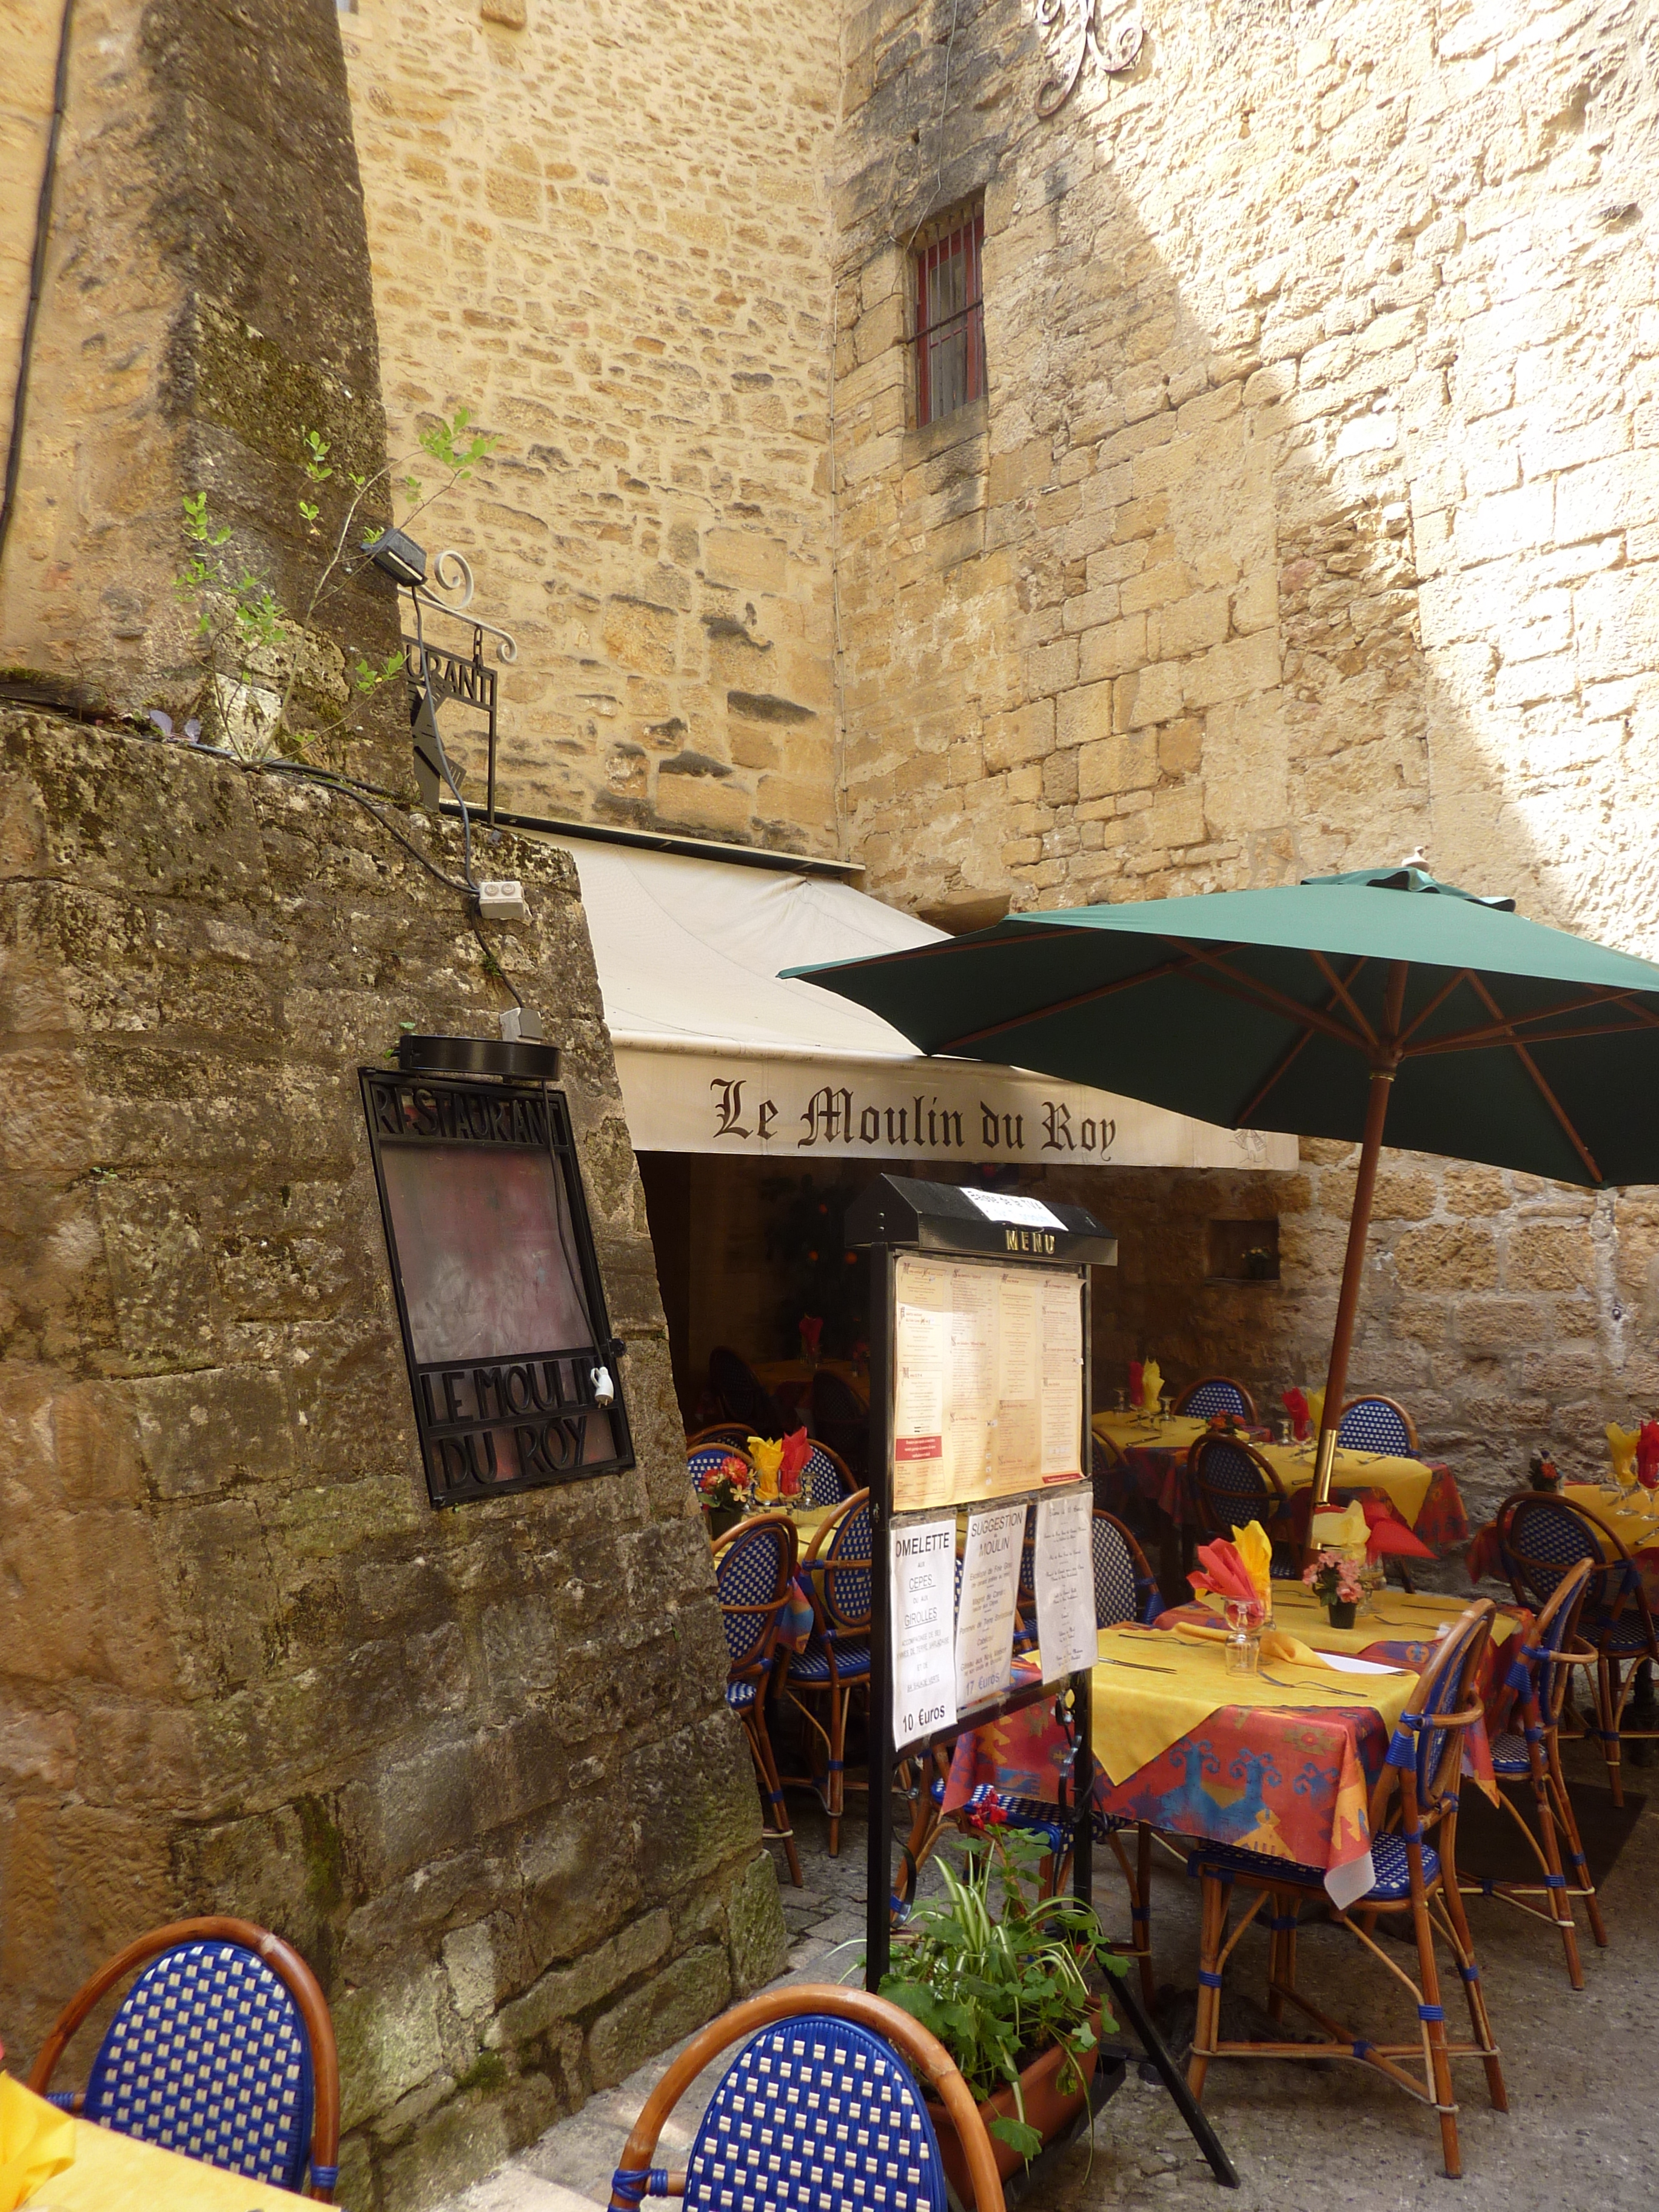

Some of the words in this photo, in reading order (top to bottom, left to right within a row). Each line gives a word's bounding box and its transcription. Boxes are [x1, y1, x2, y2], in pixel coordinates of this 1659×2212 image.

[370, 1083, 559, 1145] RESTAURANT
[710, 1078, 779, 1140] Le
[797, 1086, 965, 1148] Moulin
[980, 1101, 1026, 1149] du
[1041, 1101, 1116, 1162] Roy
[1005, 1229, 1055, 1255] MENU
[420, 1371, 474, 1426] LE
[438, 1431, 498, 1489] DU
[515, 1415, 588, 1477] ROY
[971, 1511, 1023, 1537] SUGGESTION
[896, 1532, 950, 1558] OMELETTE
[979, 1537, 1010, 1557] MOULIN
[909, 1574, 933, 1590] CEPES
[904, 1607, 937, 1627] GIROLLES
[966, 1680, 974, 1696] 17
[978, 1672, 1000, 1691] €uros
[902, 1713, 914, 1733] 10
[919, 1704, 945, 1726] €uros
